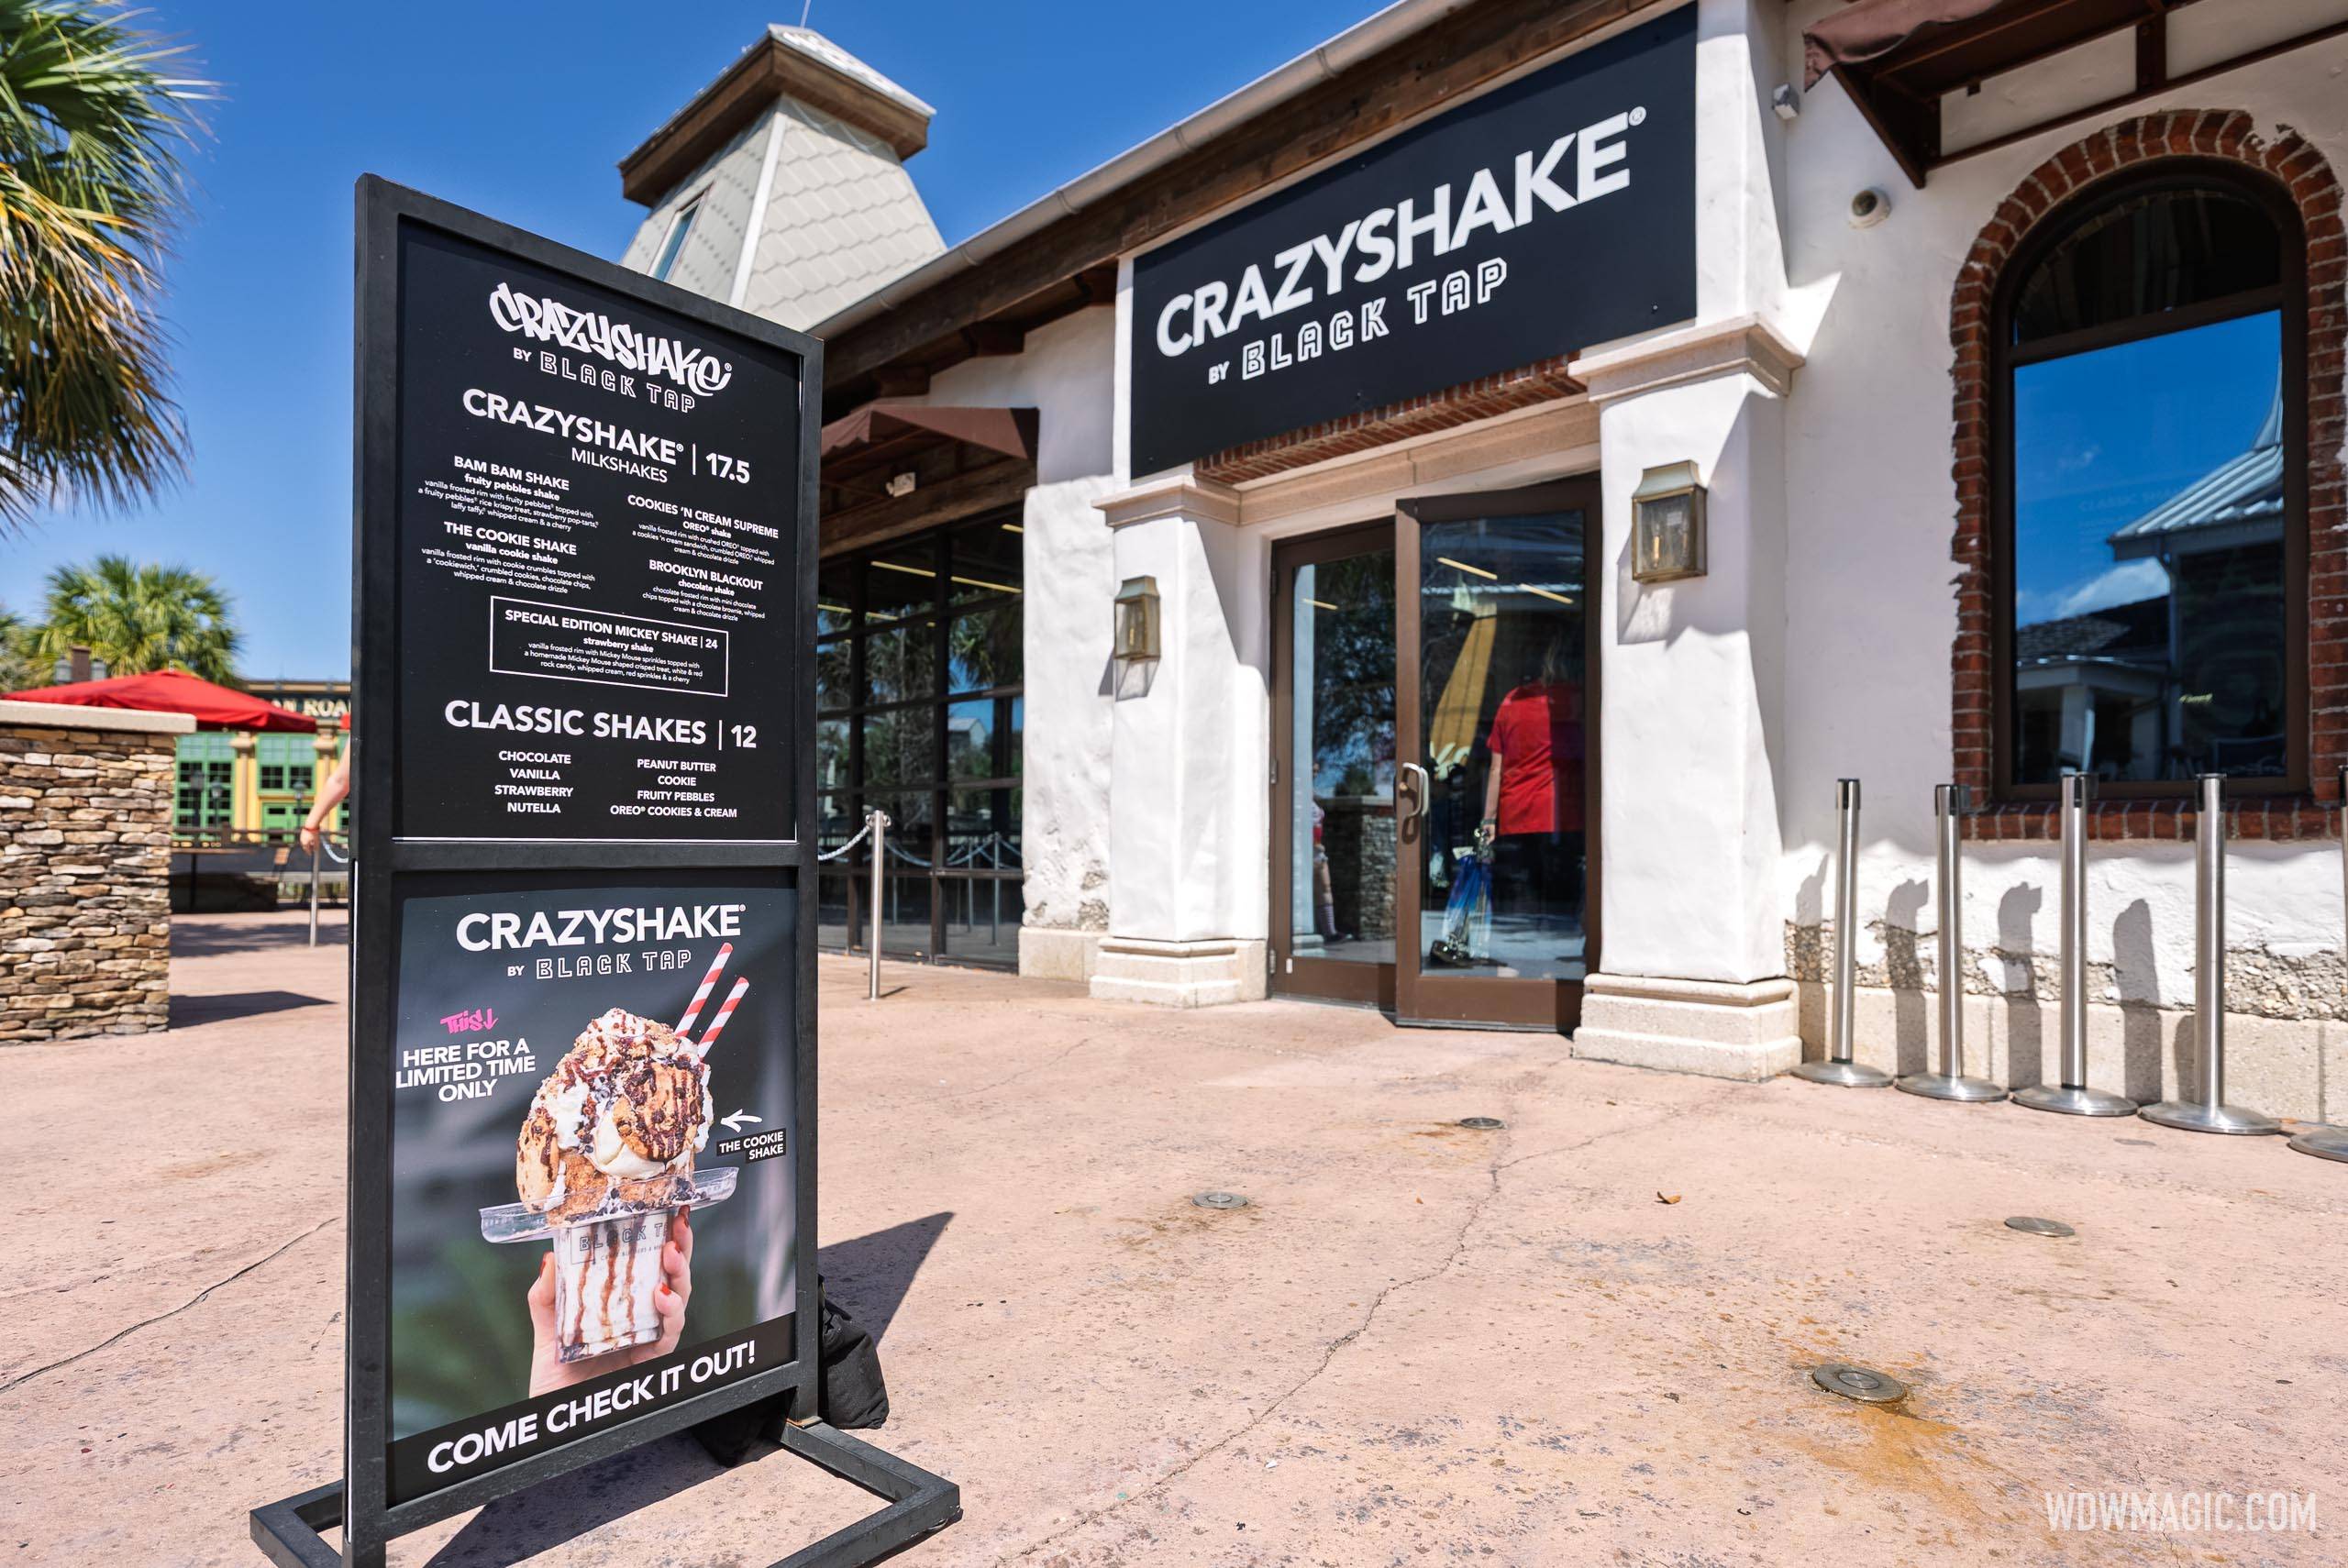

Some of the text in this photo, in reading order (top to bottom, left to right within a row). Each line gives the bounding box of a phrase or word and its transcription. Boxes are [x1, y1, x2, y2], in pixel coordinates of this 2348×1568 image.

[1208, 257, 1507, 384] BY BLACK TAP
[514, 348, 695, 413] BY BLACK TAP
[454, 456, 569, 491] BAM BAM SHAKE
[571, 447, 667, 482] MILKSHAKES
[425, 480, 448, 490] vanilla
[449, 484, 475, 495] frosted
[505, 494, 523, 505] fruity
[555, 505, 579, 515] topped
[463, 473, 559, 501] fruity pebbles shake
[424, 488, 444, 499] fruity
[493, 501, 513, 512] krispy
[532, 510, 566, 523] strawberry
[450, 502, 466, 512] laffy
[487, 509, 516, 520] whipped
[517, 515, 537, 524] cream
[551, 521, 571, 532] cherry
[627, 494, 678, 514] COOKIES
[694, 510, 731, 527] CREAM
[733, 519, 778, 538] SUPREME
[443, 521, 576, 555] THE COOKIE SHAKE
[710, 527, 731, 538] shake
[421, 547, 445, 557] vanilla
[446, 550, 471, 560] frosted
[502, 561, 525, 569] cookie
[526, 565, 556, 574] crumbles
[557, 569, 581, 579] topped
[465, 542, 558, 564] vanilla cookie shake
[453, 570, 484, 580] whipped
[515, 579, 547, 590] chocolate
[547, 584, 568, 593] drizzle
[648, 558, 763, 590] BROOKLYN BLACKOUT
[678, 579, 735, 596] chocolate shake
[504, 609, 717, 648] SPECIAL EDITION MICKEY SHAKE 24
[549, 644, 572, 653] frosted
[599, 650, 620, 660] Mickey
[621, 652, 641, 661] Mouse
[582, 636, 653, 652] strawberry shake
[445, 700, 756, 748] CLASSIC SHAKES 12
[498, 750, 570, 764] CHOCOLATE
[637, 758, 715, 772] PEANUT BUTTER
[509, 767, 560, 779] VANILLA
[657, 775, 696, 786] COOKIE
[494, 784, 573, 797] STRAWBERRY
[637, 790, 714, 801] FRUITY PEBBLES
[507, 801, 560, 812] NUTELLA
[647, 806, 692, 816] COOKIES
[693, 807, 702, 816] &
[703, 807, 737, 817] CREAM
[507, 949, 692, 979] BY BLACK TAP
[403, 1038, 531, 1068] HERE FOR A
[395, 1055, 537, 1088] LIMITED TIME
[437, 1078, 498, 1102] ONLY
[719, 1131, 783, 1154] THE COOKIE
[748, 1143, 783, 1160] SHAKE
[427, 1340, 756, 1474] COME CHECK IT OUT!
